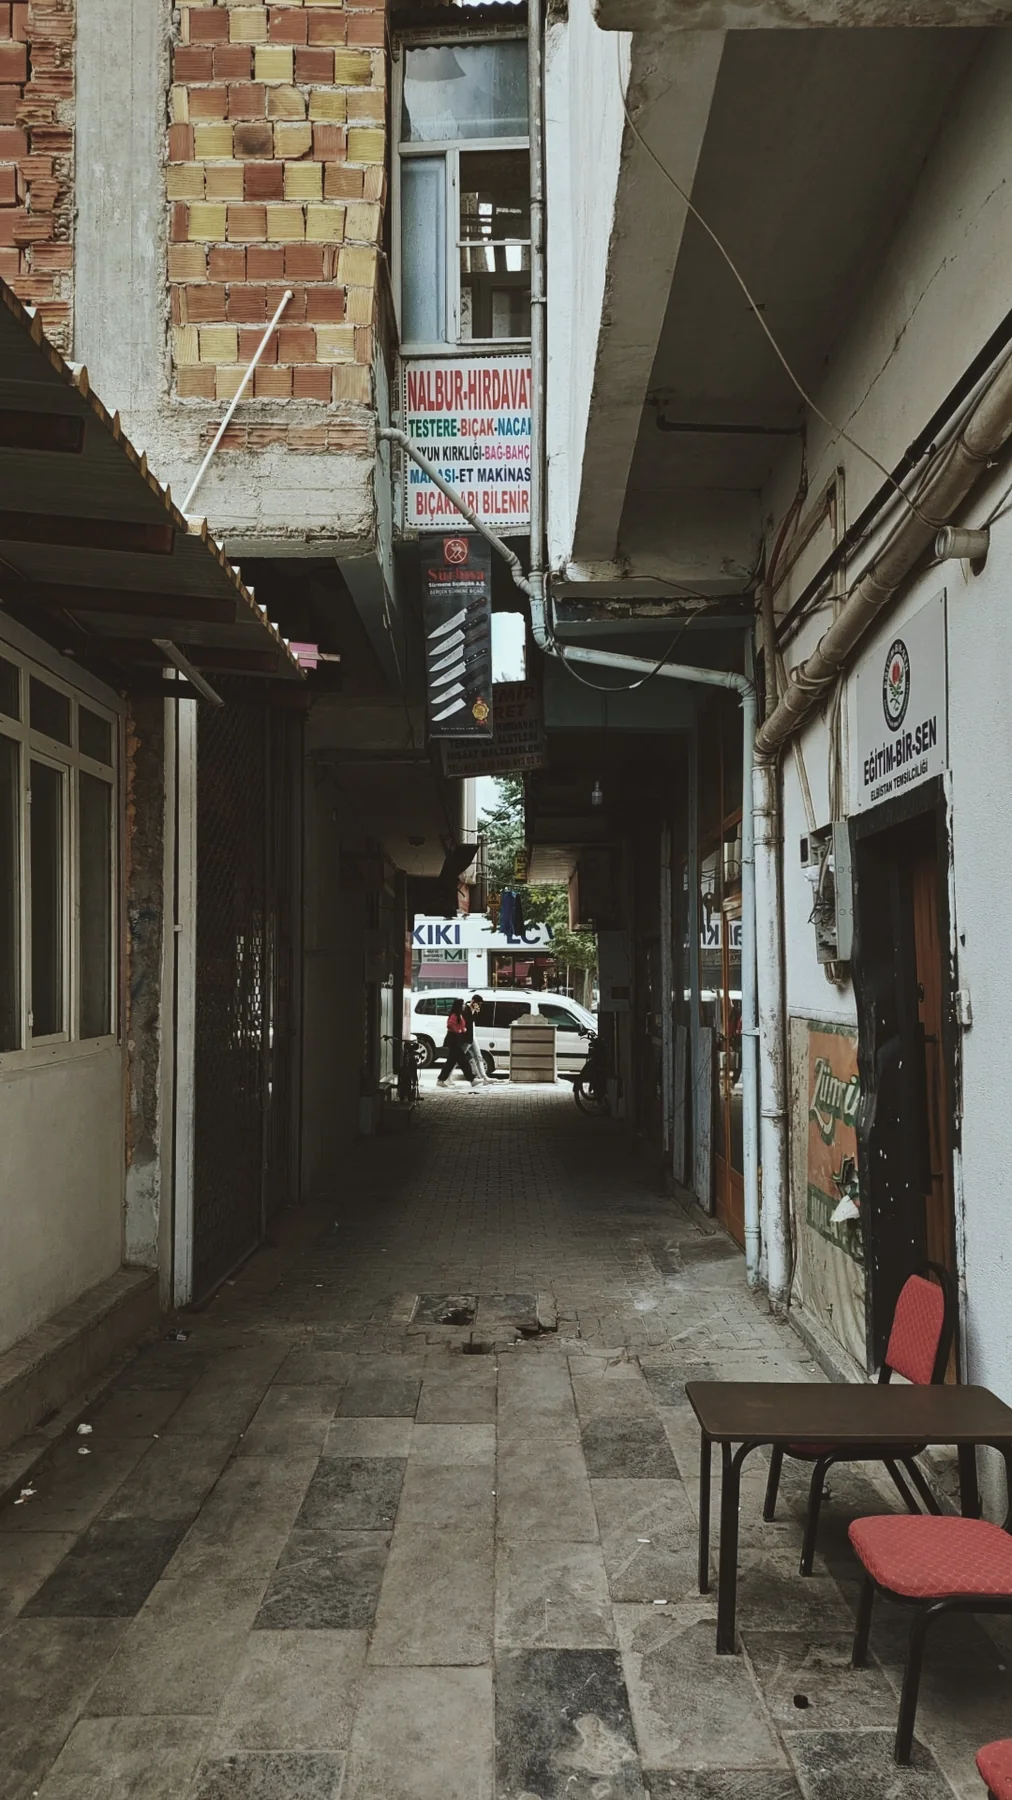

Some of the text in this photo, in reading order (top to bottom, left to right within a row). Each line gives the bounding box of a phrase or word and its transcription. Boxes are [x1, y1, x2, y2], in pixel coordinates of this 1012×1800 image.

[408, 368, 532, 411] NALBUR-HIRDAVAT
[443, 442, 531, 464] KIRKLIĞI-BAĞ-BAHÇ
[483, 485, 529, 514] BİLENİR
[863, 715, 937, 787] EĞİTİM-BİR-SEN
